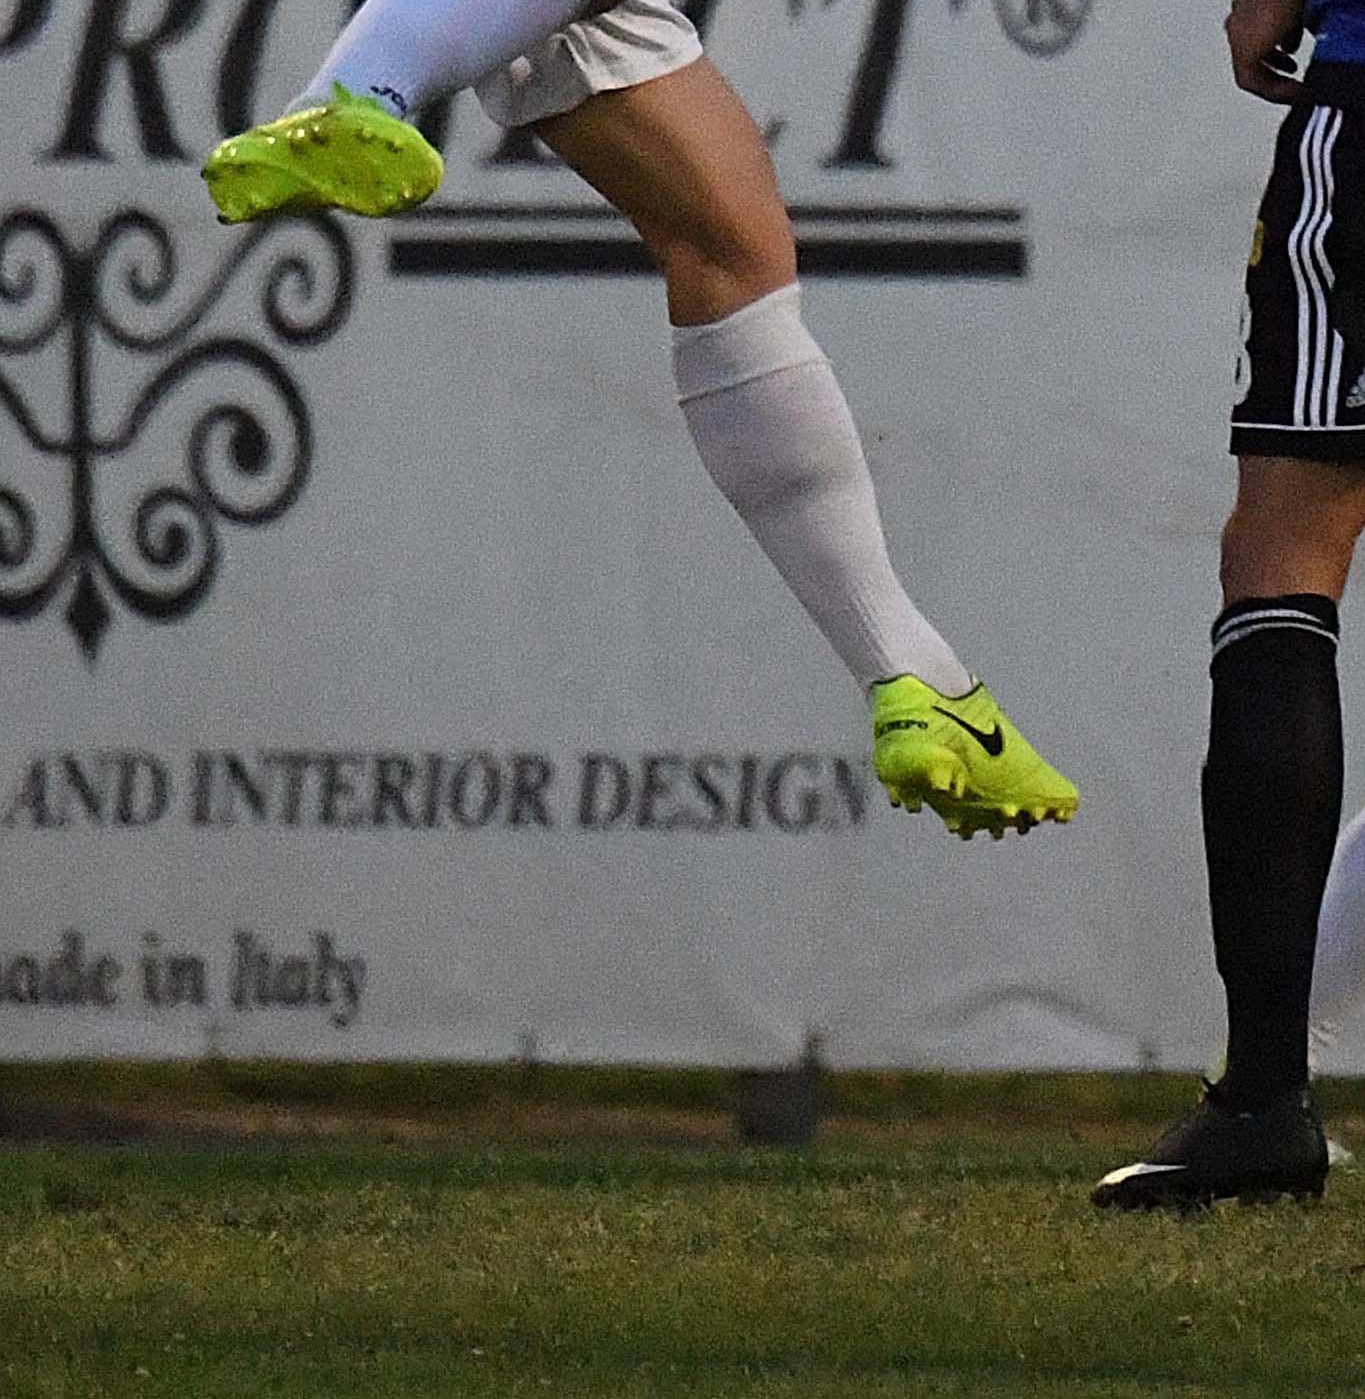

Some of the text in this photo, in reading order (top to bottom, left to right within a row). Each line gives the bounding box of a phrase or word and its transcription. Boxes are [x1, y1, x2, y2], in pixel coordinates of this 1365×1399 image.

[3, 747, 864, 833] AND INTERIOR DESIGN
[139, 930, 205, 1006] in
[232, 928, 368, 1030] Italy
